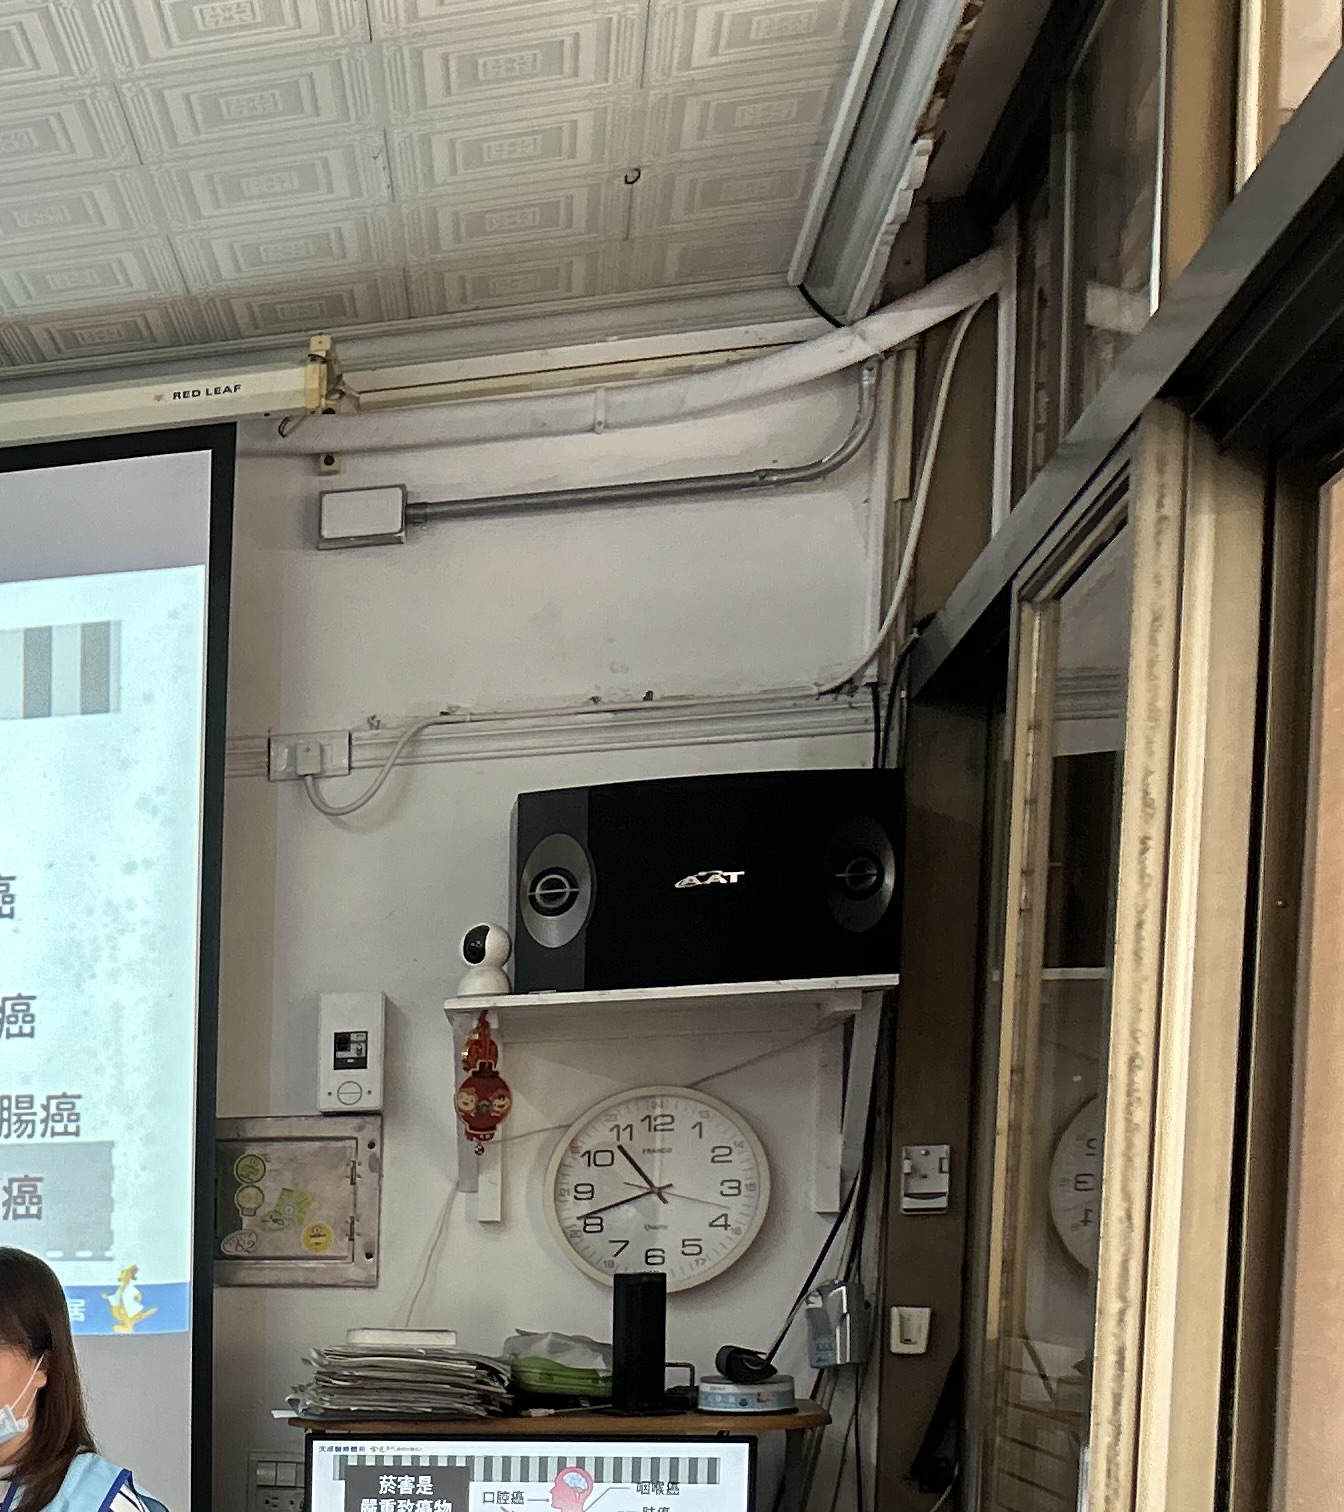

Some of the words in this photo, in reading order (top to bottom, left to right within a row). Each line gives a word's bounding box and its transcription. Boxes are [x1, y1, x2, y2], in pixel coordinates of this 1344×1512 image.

[172, 389, 202, 401] RED
[205, 384, 242, 396] LEAF
[640, 1113, 675, 1133] 12
[691, 1121, 703, 1139] 1
[609, 1124, 634, 1142] 11
[580, 1149, 615, 1168] 10
[710, 1145, 733, 1164] 2
[573, 1182, 595, 1201] 9
[719, 1179, 742, 1197] 3
[583, 1215, 604, 1234] 8
[708, 1213, 731, 1231] 4
[608, 1239, 630, 1258] 7
[644, 1247, 666, 1266] 6
[681, 1238, 703, 1256] 5
[378, 1474, 434, 1495] 菸害是
[482, 1490, 525, 1505] 口腔癌
